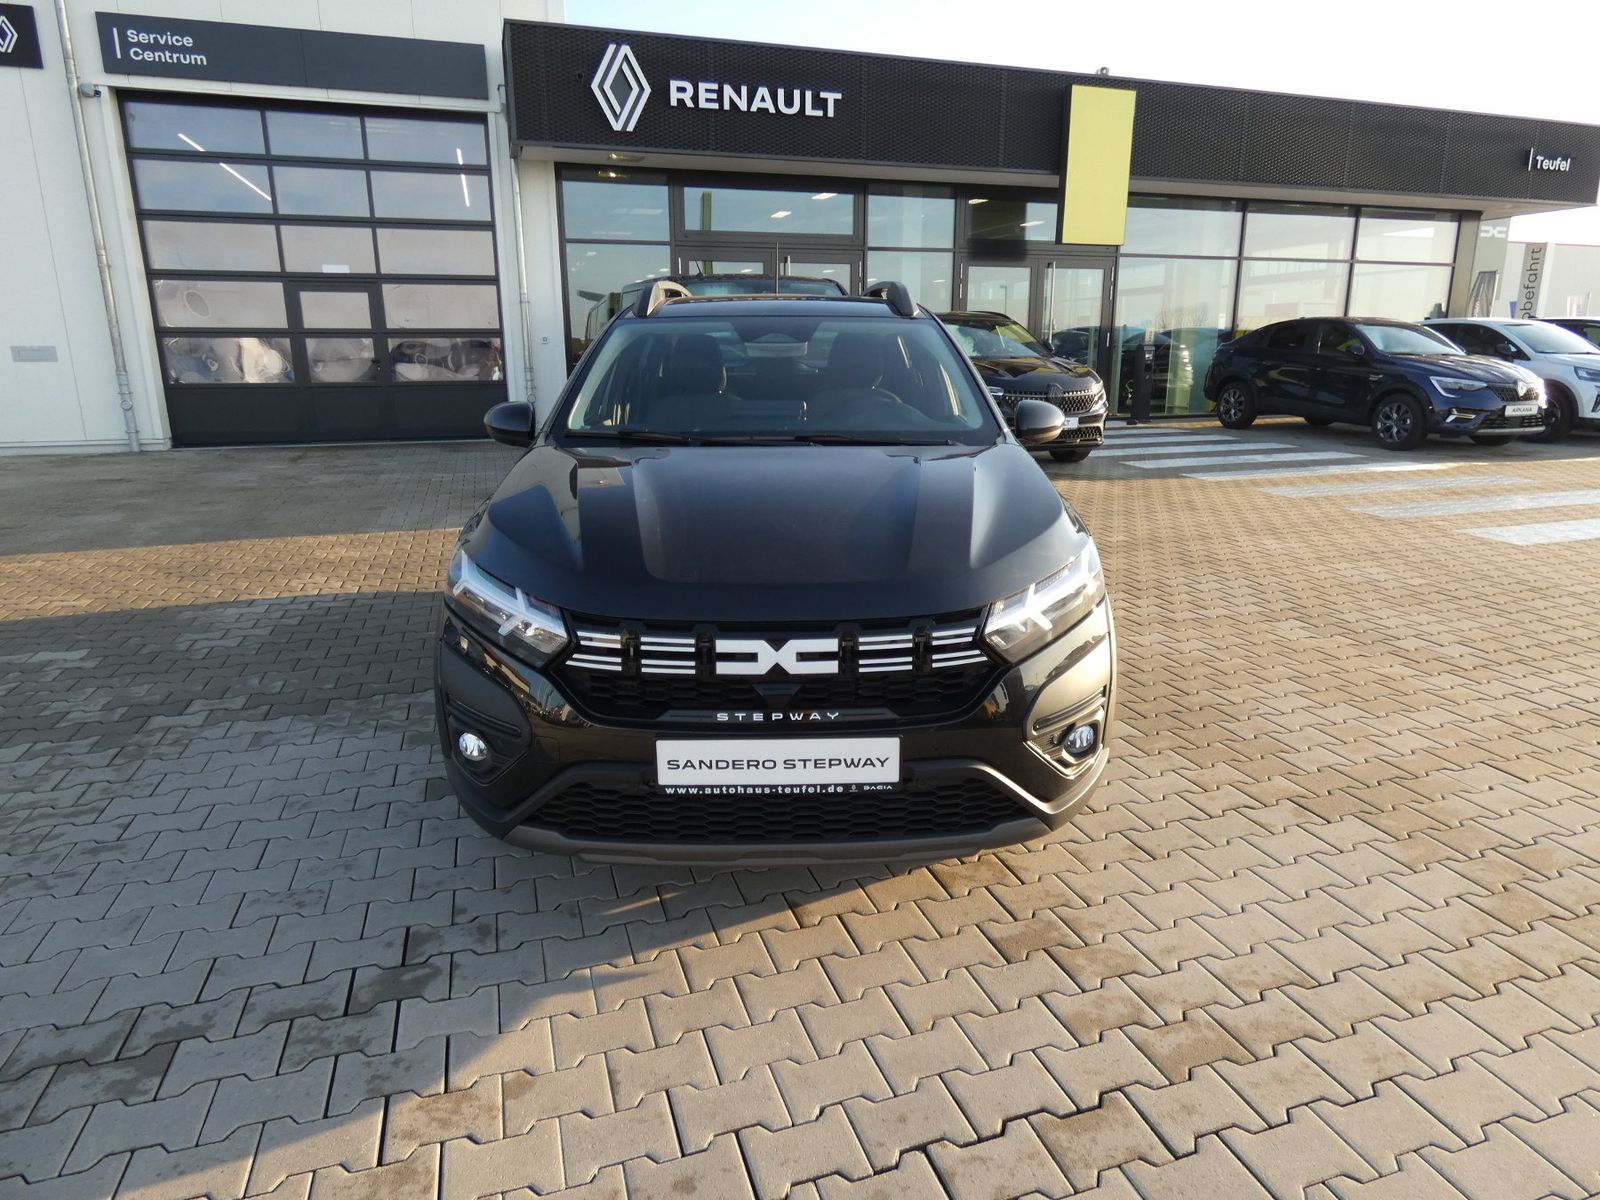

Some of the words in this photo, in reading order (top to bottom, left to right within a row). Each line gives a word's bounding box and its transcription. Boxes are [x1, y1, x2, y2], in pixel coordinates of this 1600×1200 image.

[126, 28, 194, 47] Service
[129, 47, 208, 66] Centrum
[669, 79, 842, 117] RENAULT
[1536, 155, 1571, 171] Teufel
[716, 712, 839, 721] STEPWAY
[666, 758, 778, 771] SANDERO
[783, 757, 890, 769] STEPWAY
[665, 784, 845, 795] www.autohaus-teufel.de
